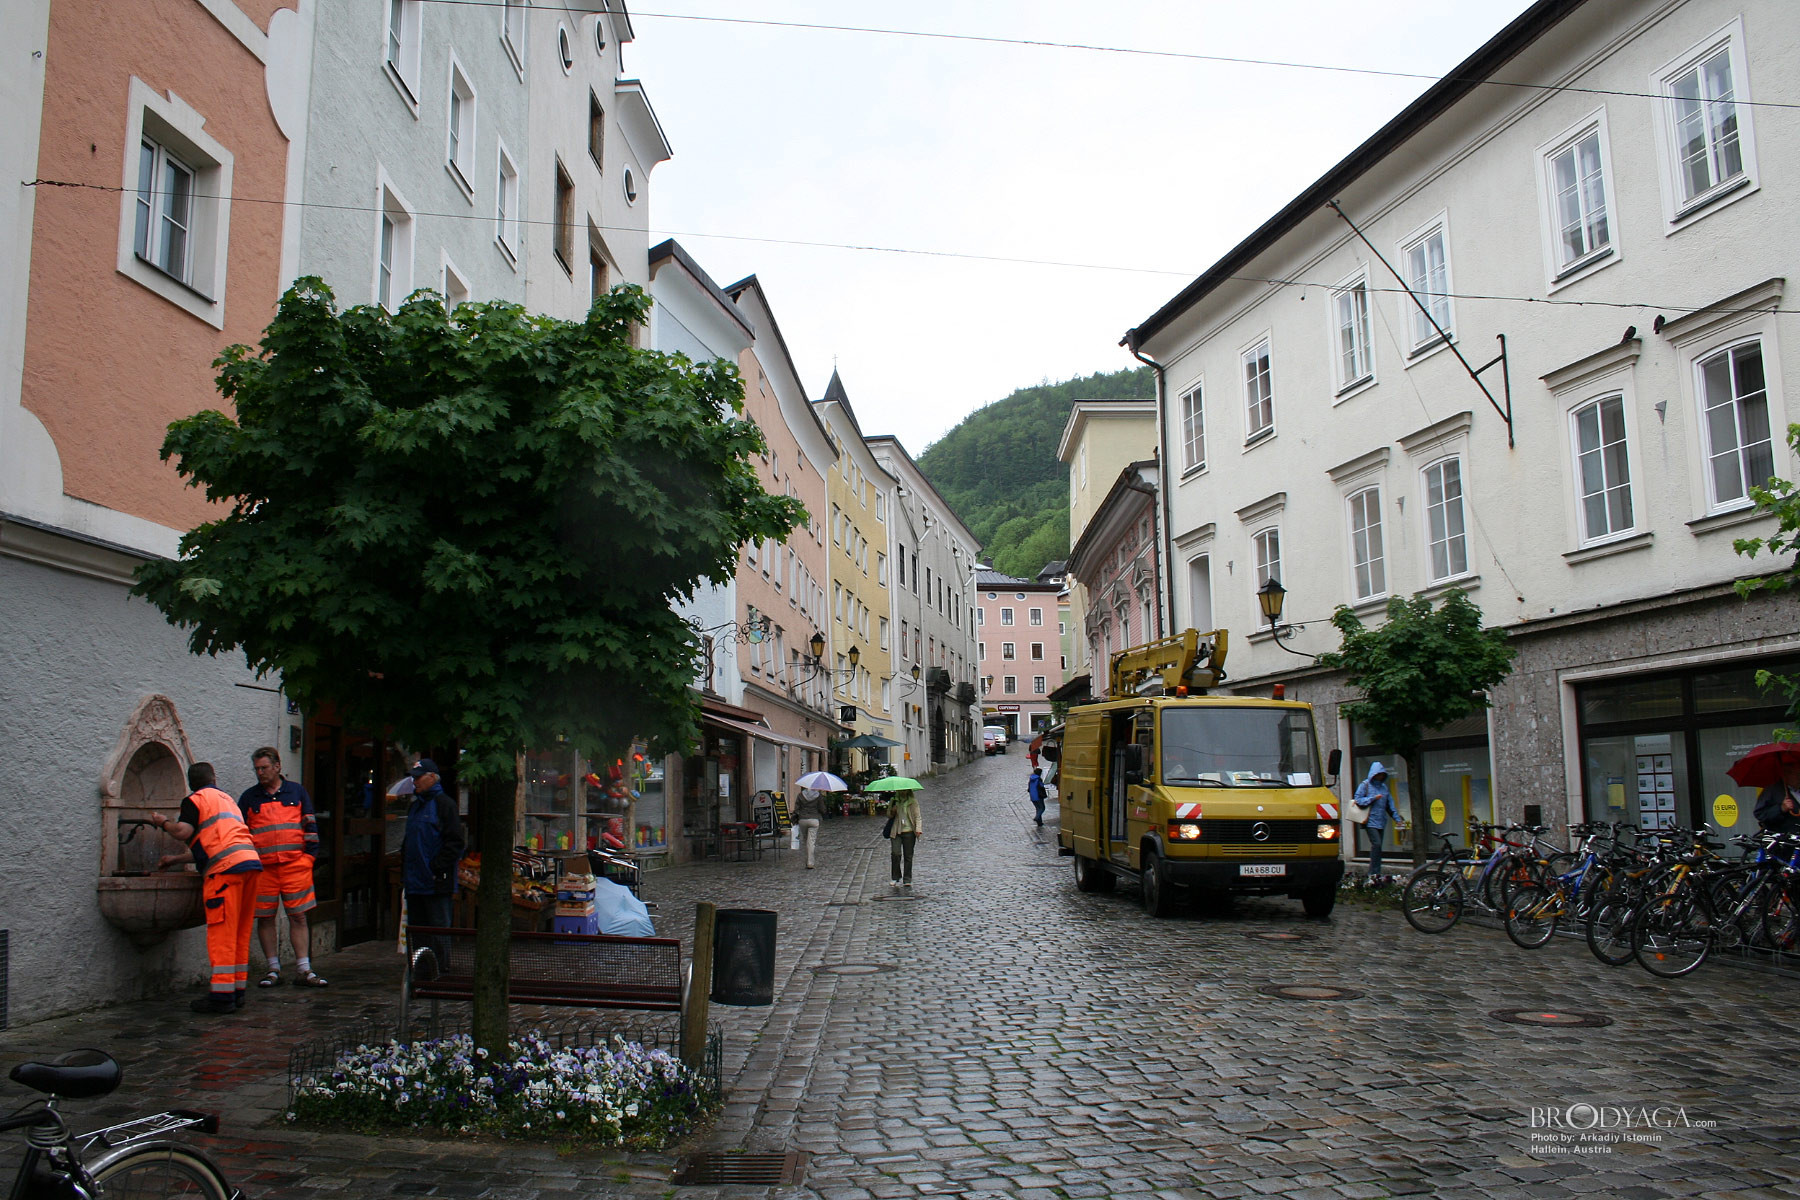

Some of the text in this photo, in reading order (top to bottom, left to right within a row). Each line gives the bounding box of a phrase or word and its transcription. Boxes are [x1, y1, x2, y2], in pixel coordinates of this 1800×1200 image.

[1244, 866, 1280, 874] HA 68 CU
